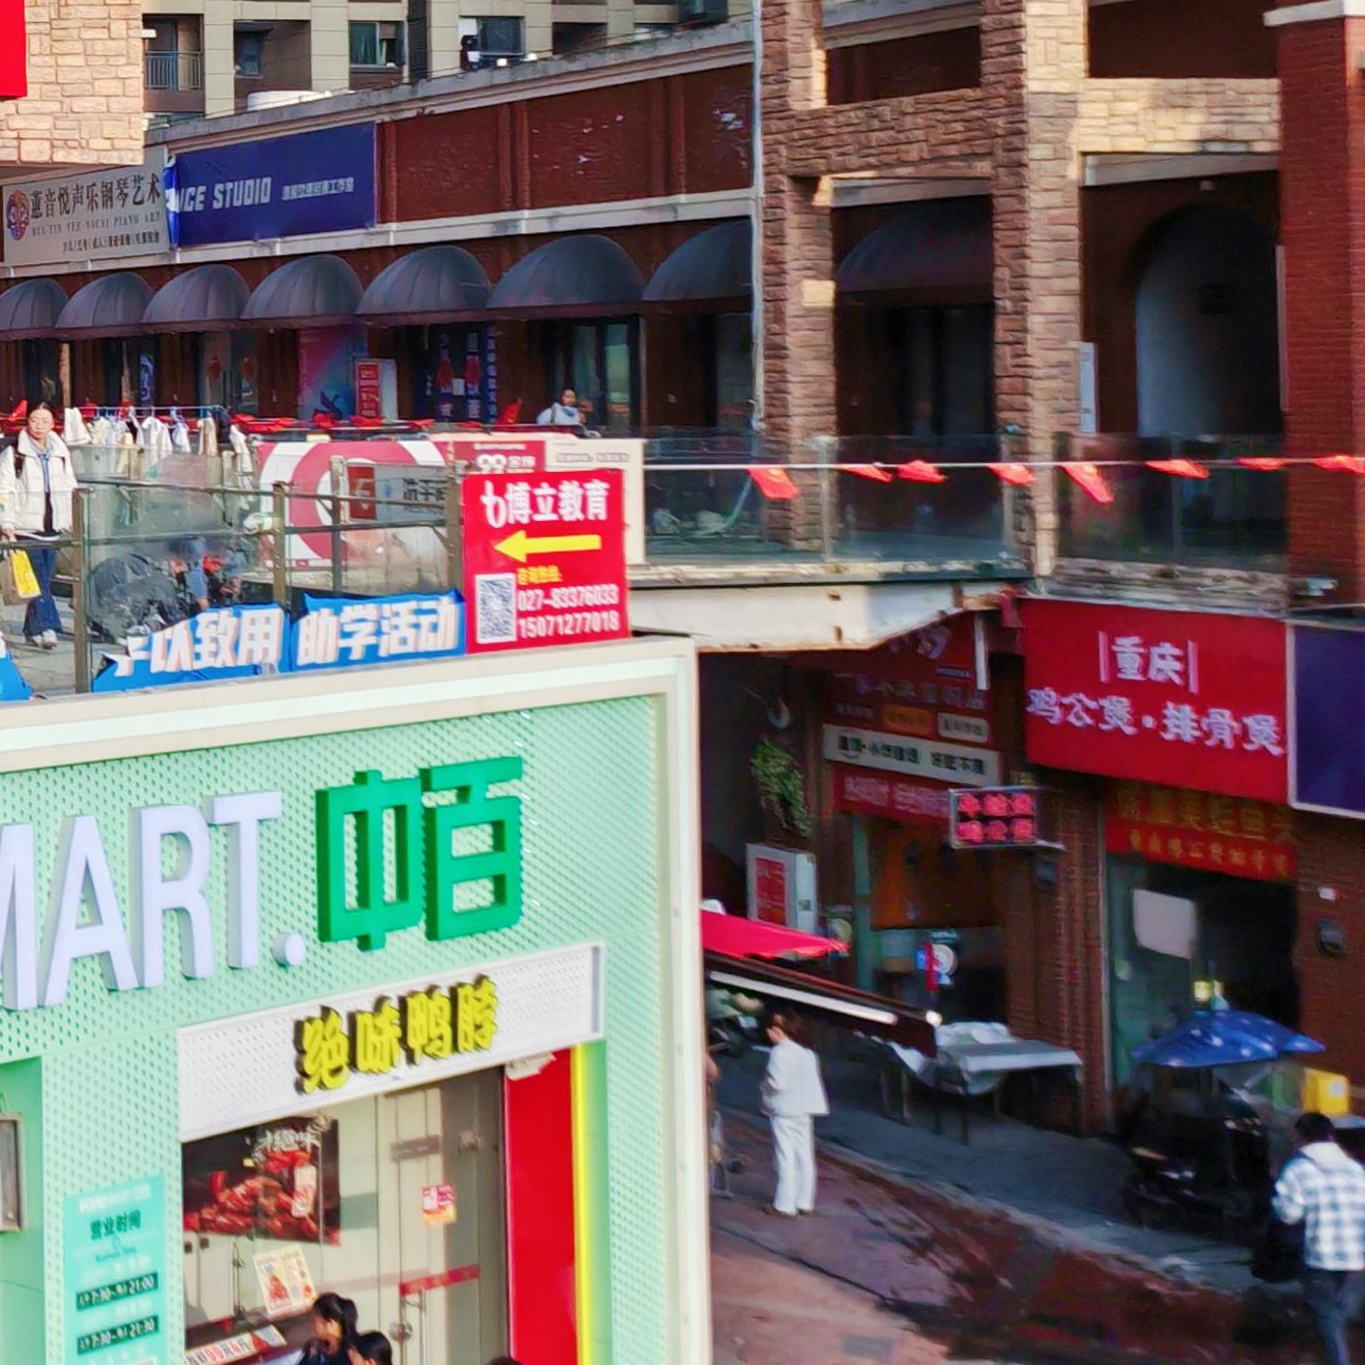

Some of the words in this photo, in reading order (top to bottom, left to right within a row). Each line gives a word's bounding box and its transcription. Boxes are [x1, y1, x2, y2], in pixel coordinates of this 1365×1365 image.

[212, 177, 272, 210] STUDIO
[505, 478, 610, 525] 博立教育
[298, 599, 459, 667] 助学活动
[1111, 634, 1185, 685] 重庆
[315, 756, 525, 952] 中百
[296, 975, 499, 1095] 绝味鸭脖
